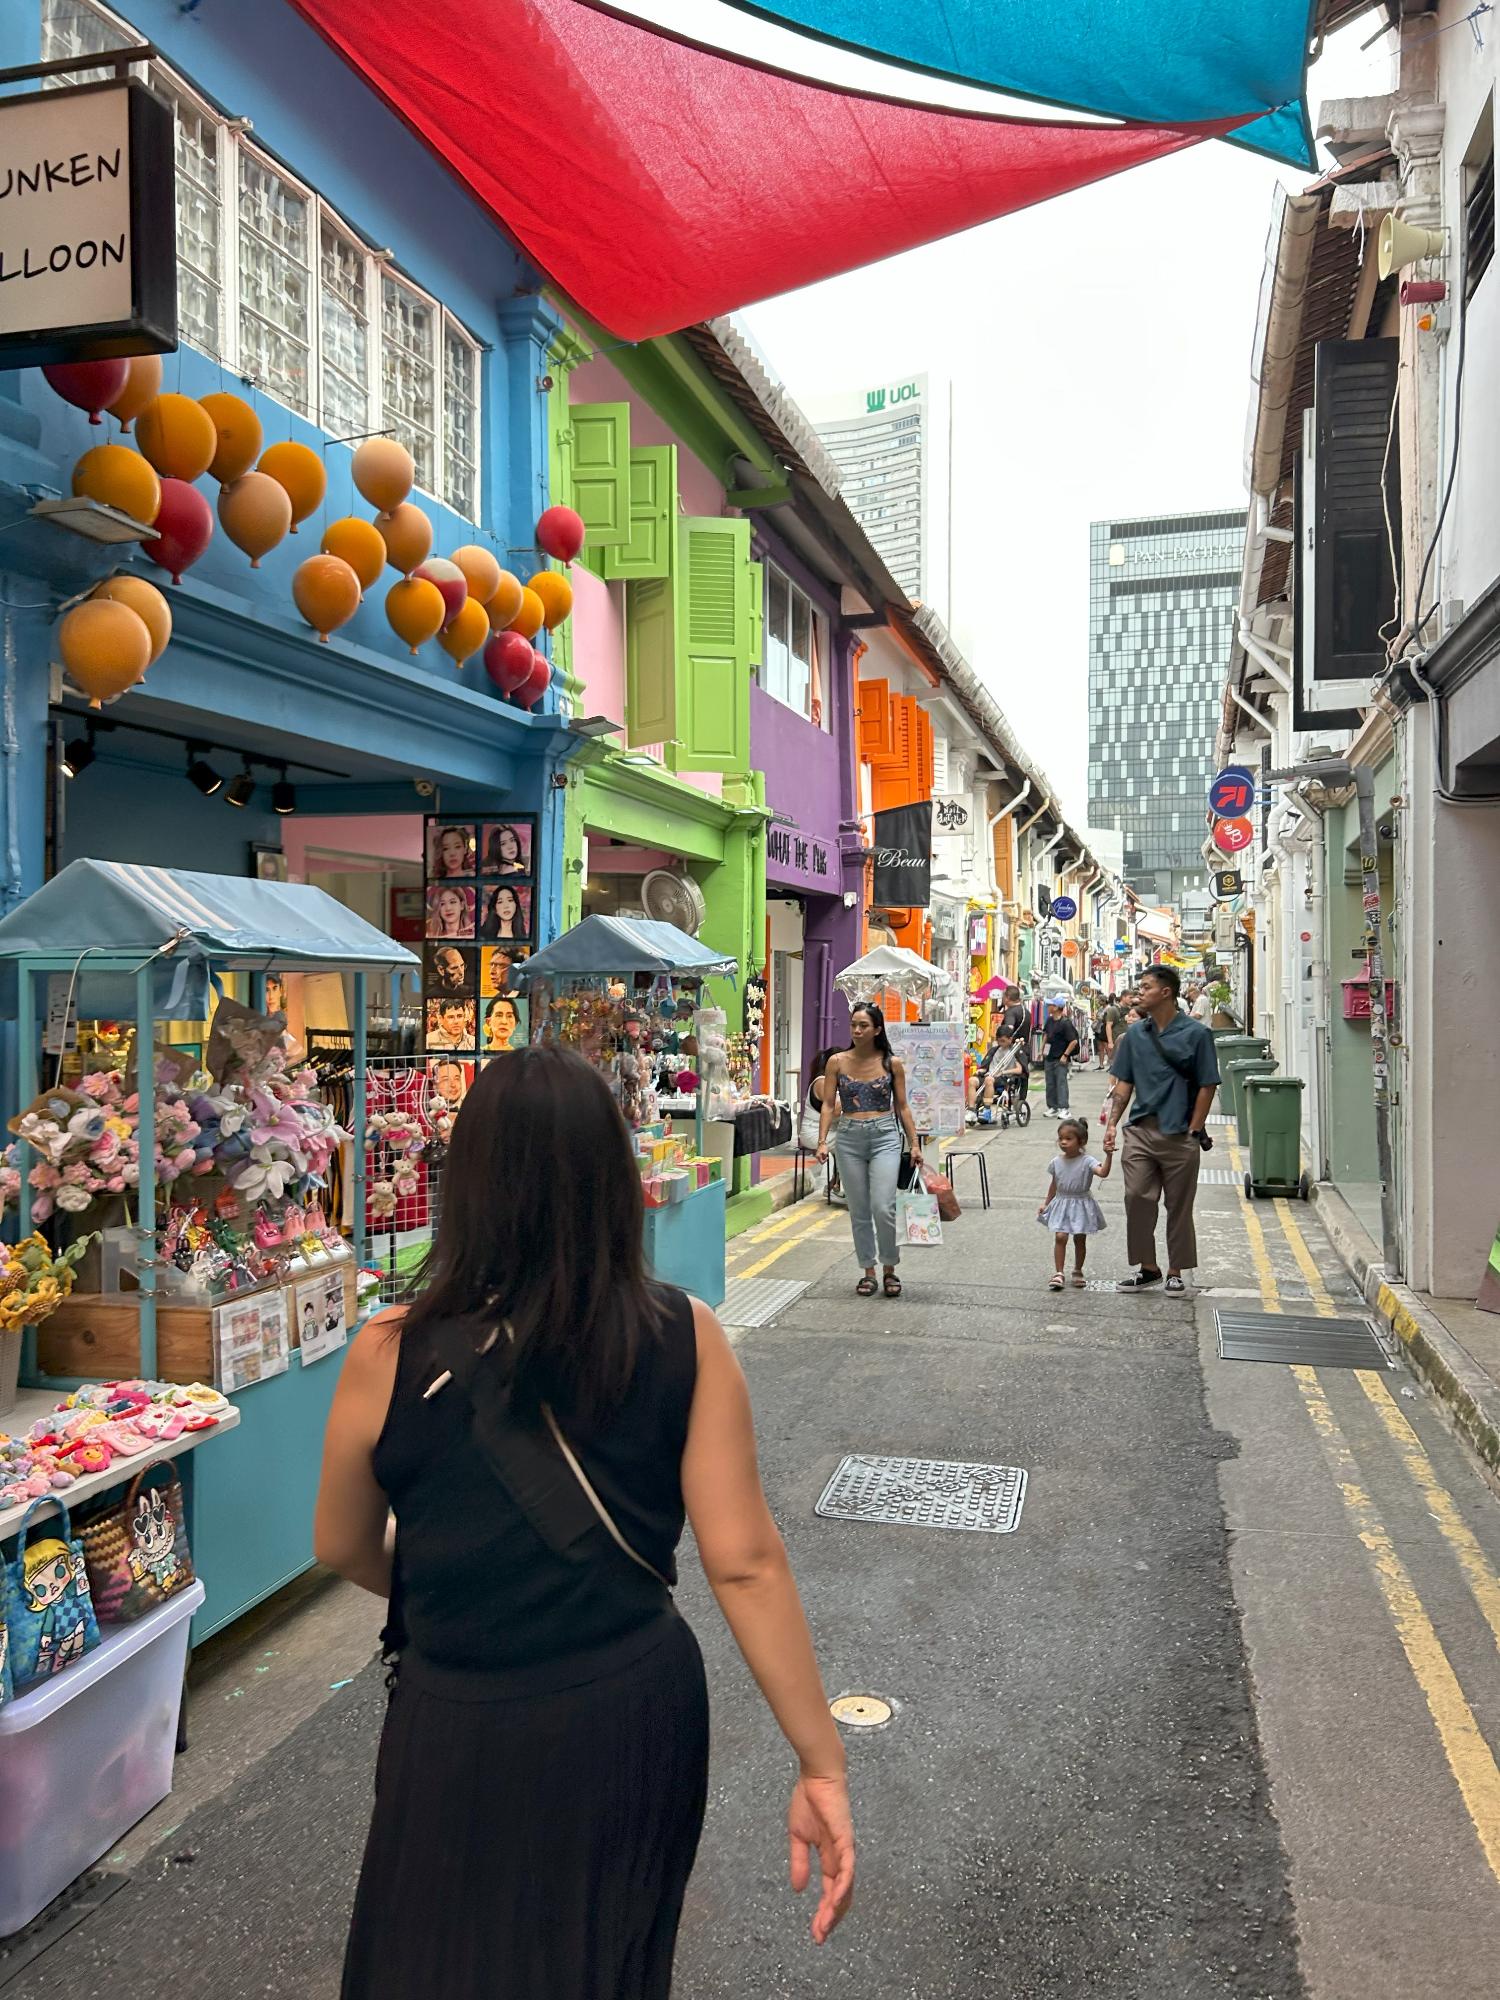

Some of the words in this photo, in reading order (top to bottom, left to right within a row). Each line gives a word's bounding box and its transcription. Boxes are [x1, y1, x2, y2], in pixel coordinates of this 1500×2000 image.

[890, 383, 921, 404] UOL
[1133, 550, 1165, 565] PAN
[1173, 544, 1234, 561] PACIFIC
[767, 830, 790, 866] WHAT
[793, 836, 808, 870] THE
[878, 848, 927, 868] Beau
